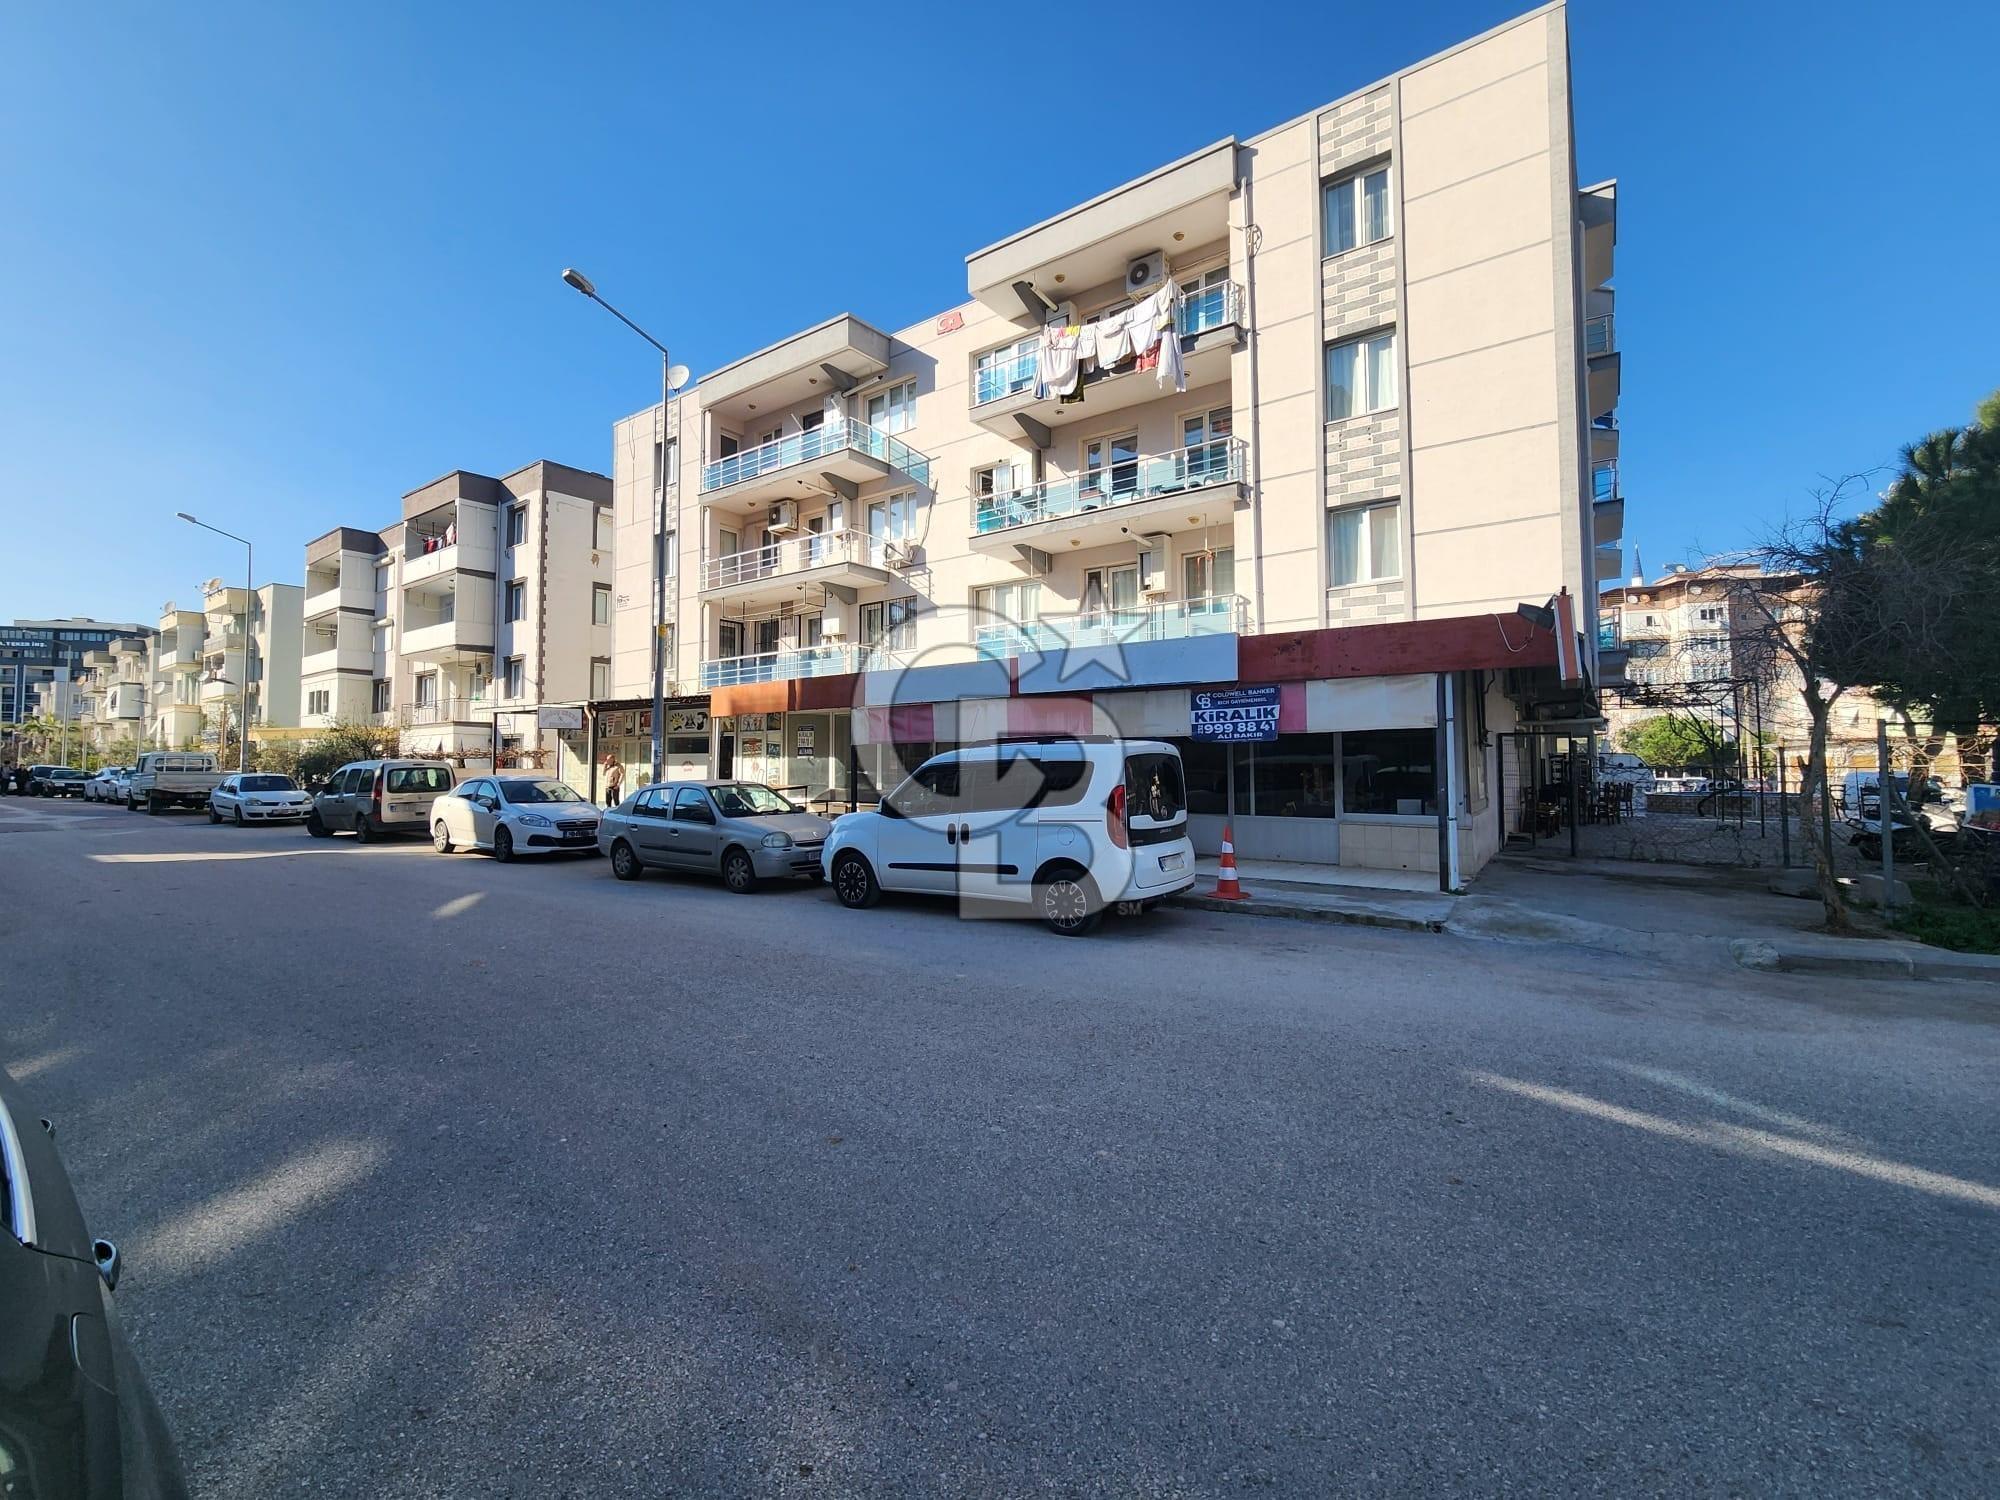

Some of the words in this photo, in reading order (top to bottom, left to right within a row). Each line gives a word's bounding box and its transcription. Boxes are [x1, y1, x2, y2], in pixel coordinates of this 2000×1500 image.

[1248, 688, 1275, 696] BANKER
[1204, 723, 1234, 734] 999
[1237, 721, 1257, 733] 88
[1260, 721, 1275, 731] 41
